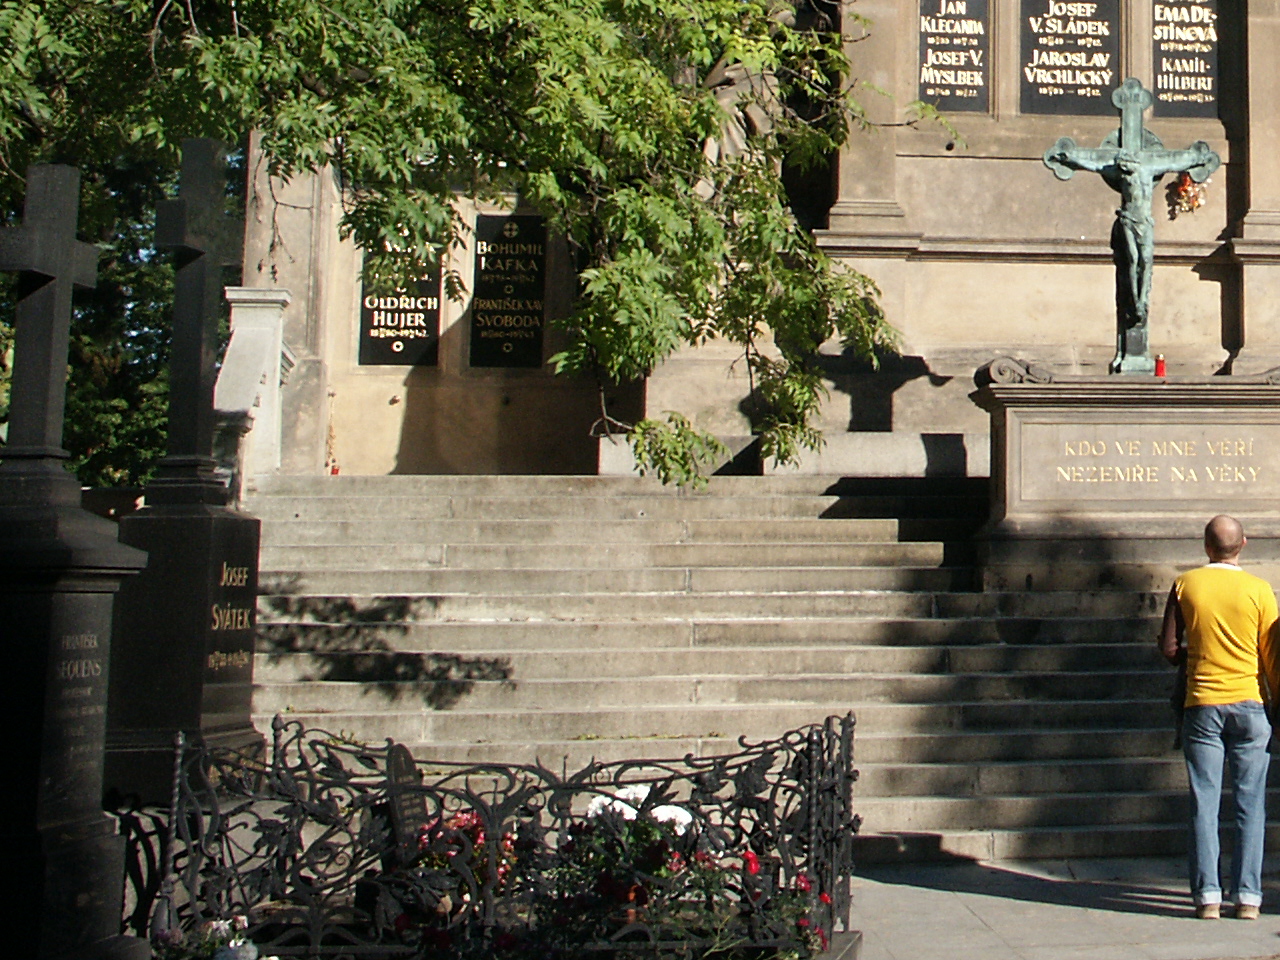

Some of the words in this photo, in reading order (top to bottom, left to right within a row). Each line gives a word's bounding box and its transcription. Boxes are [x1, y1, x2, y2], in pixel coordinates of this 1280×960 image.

[1043, 0, 1097, 18] JOSEF
[1154, 4, 1190, 23] EMA
[920, 16, 985, 35] KLECANDA
[1029, 16, 1044, 34] V.
[1045, 16, 1110, 36] SLÁDEK
[923, 48, 969, 67] JOSEF
[969, 50, 983, 67] V.
[1027, 49, 1110, 68] JAROSLAV
[920, 67, 984, 86] MYSLBEK
[1024, 66, 1113, 86] VRCHLICKÝ
[477, 241, 543, 255] BOHUMIL
[481, 256, 538, 271] KAFKA
[364, 294, 438, 310] OLDŘICH
[373, 310, 427, 328] HUJER
[476, 312, 541, 327] SVOBODA
[1065, 440, 1106, 456] KDO
[1115, 440, 1142, 456] VE
[1152, 440, 1197, 456] MNE
[1057, 464, 1160, 483] NEZEMŘE
[1170, 466, 1199, 482] NA
[1205, 463, 1262, 483] VĚKY
[220, 561, 249, 587] JOSEF
[211, 602, 251, 630] SVÁTEK
